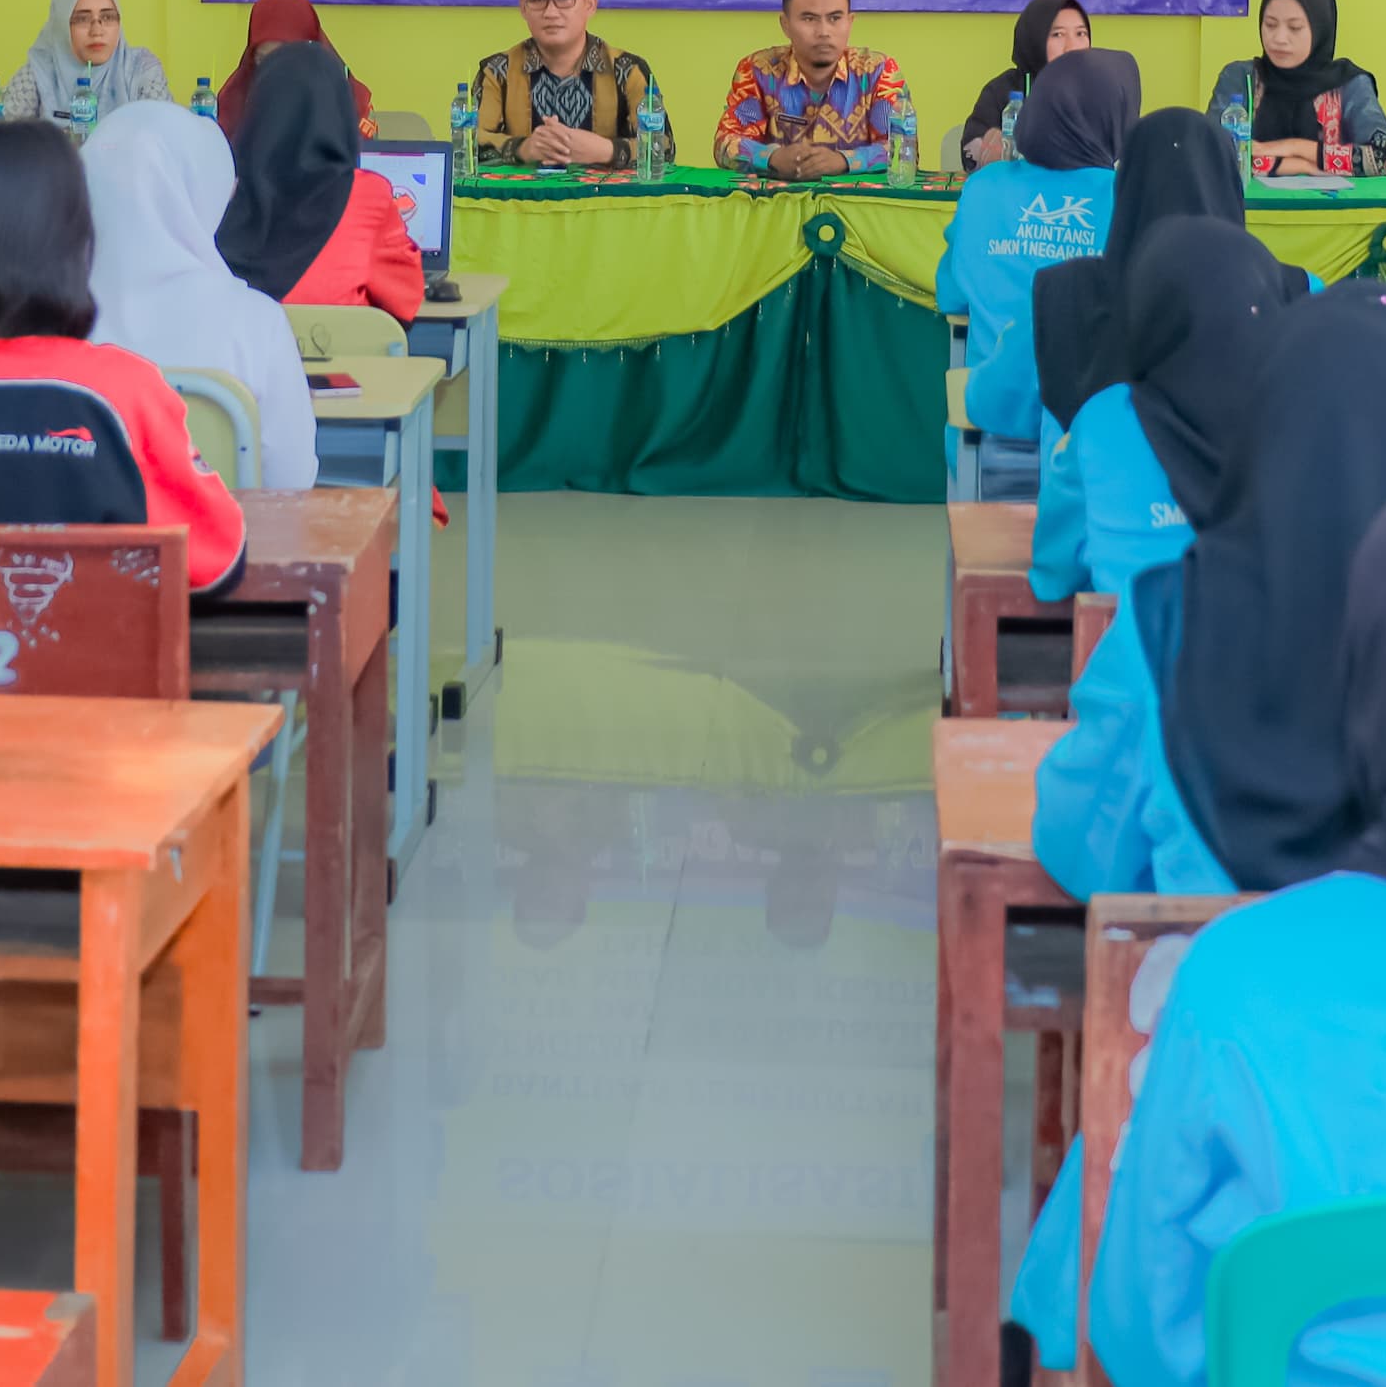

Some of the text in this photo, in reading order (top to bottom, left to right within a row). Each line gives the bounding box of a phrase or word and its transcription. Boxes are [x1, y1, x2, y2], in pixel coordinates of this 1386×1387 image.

[1017, 224, 1095, 245] AKUNTANSI
[988, 239, 1019, 255] SMKN
[1029, 241, 1084, 260] NEGARA
[33, 434, 97, 456] MOTOR
